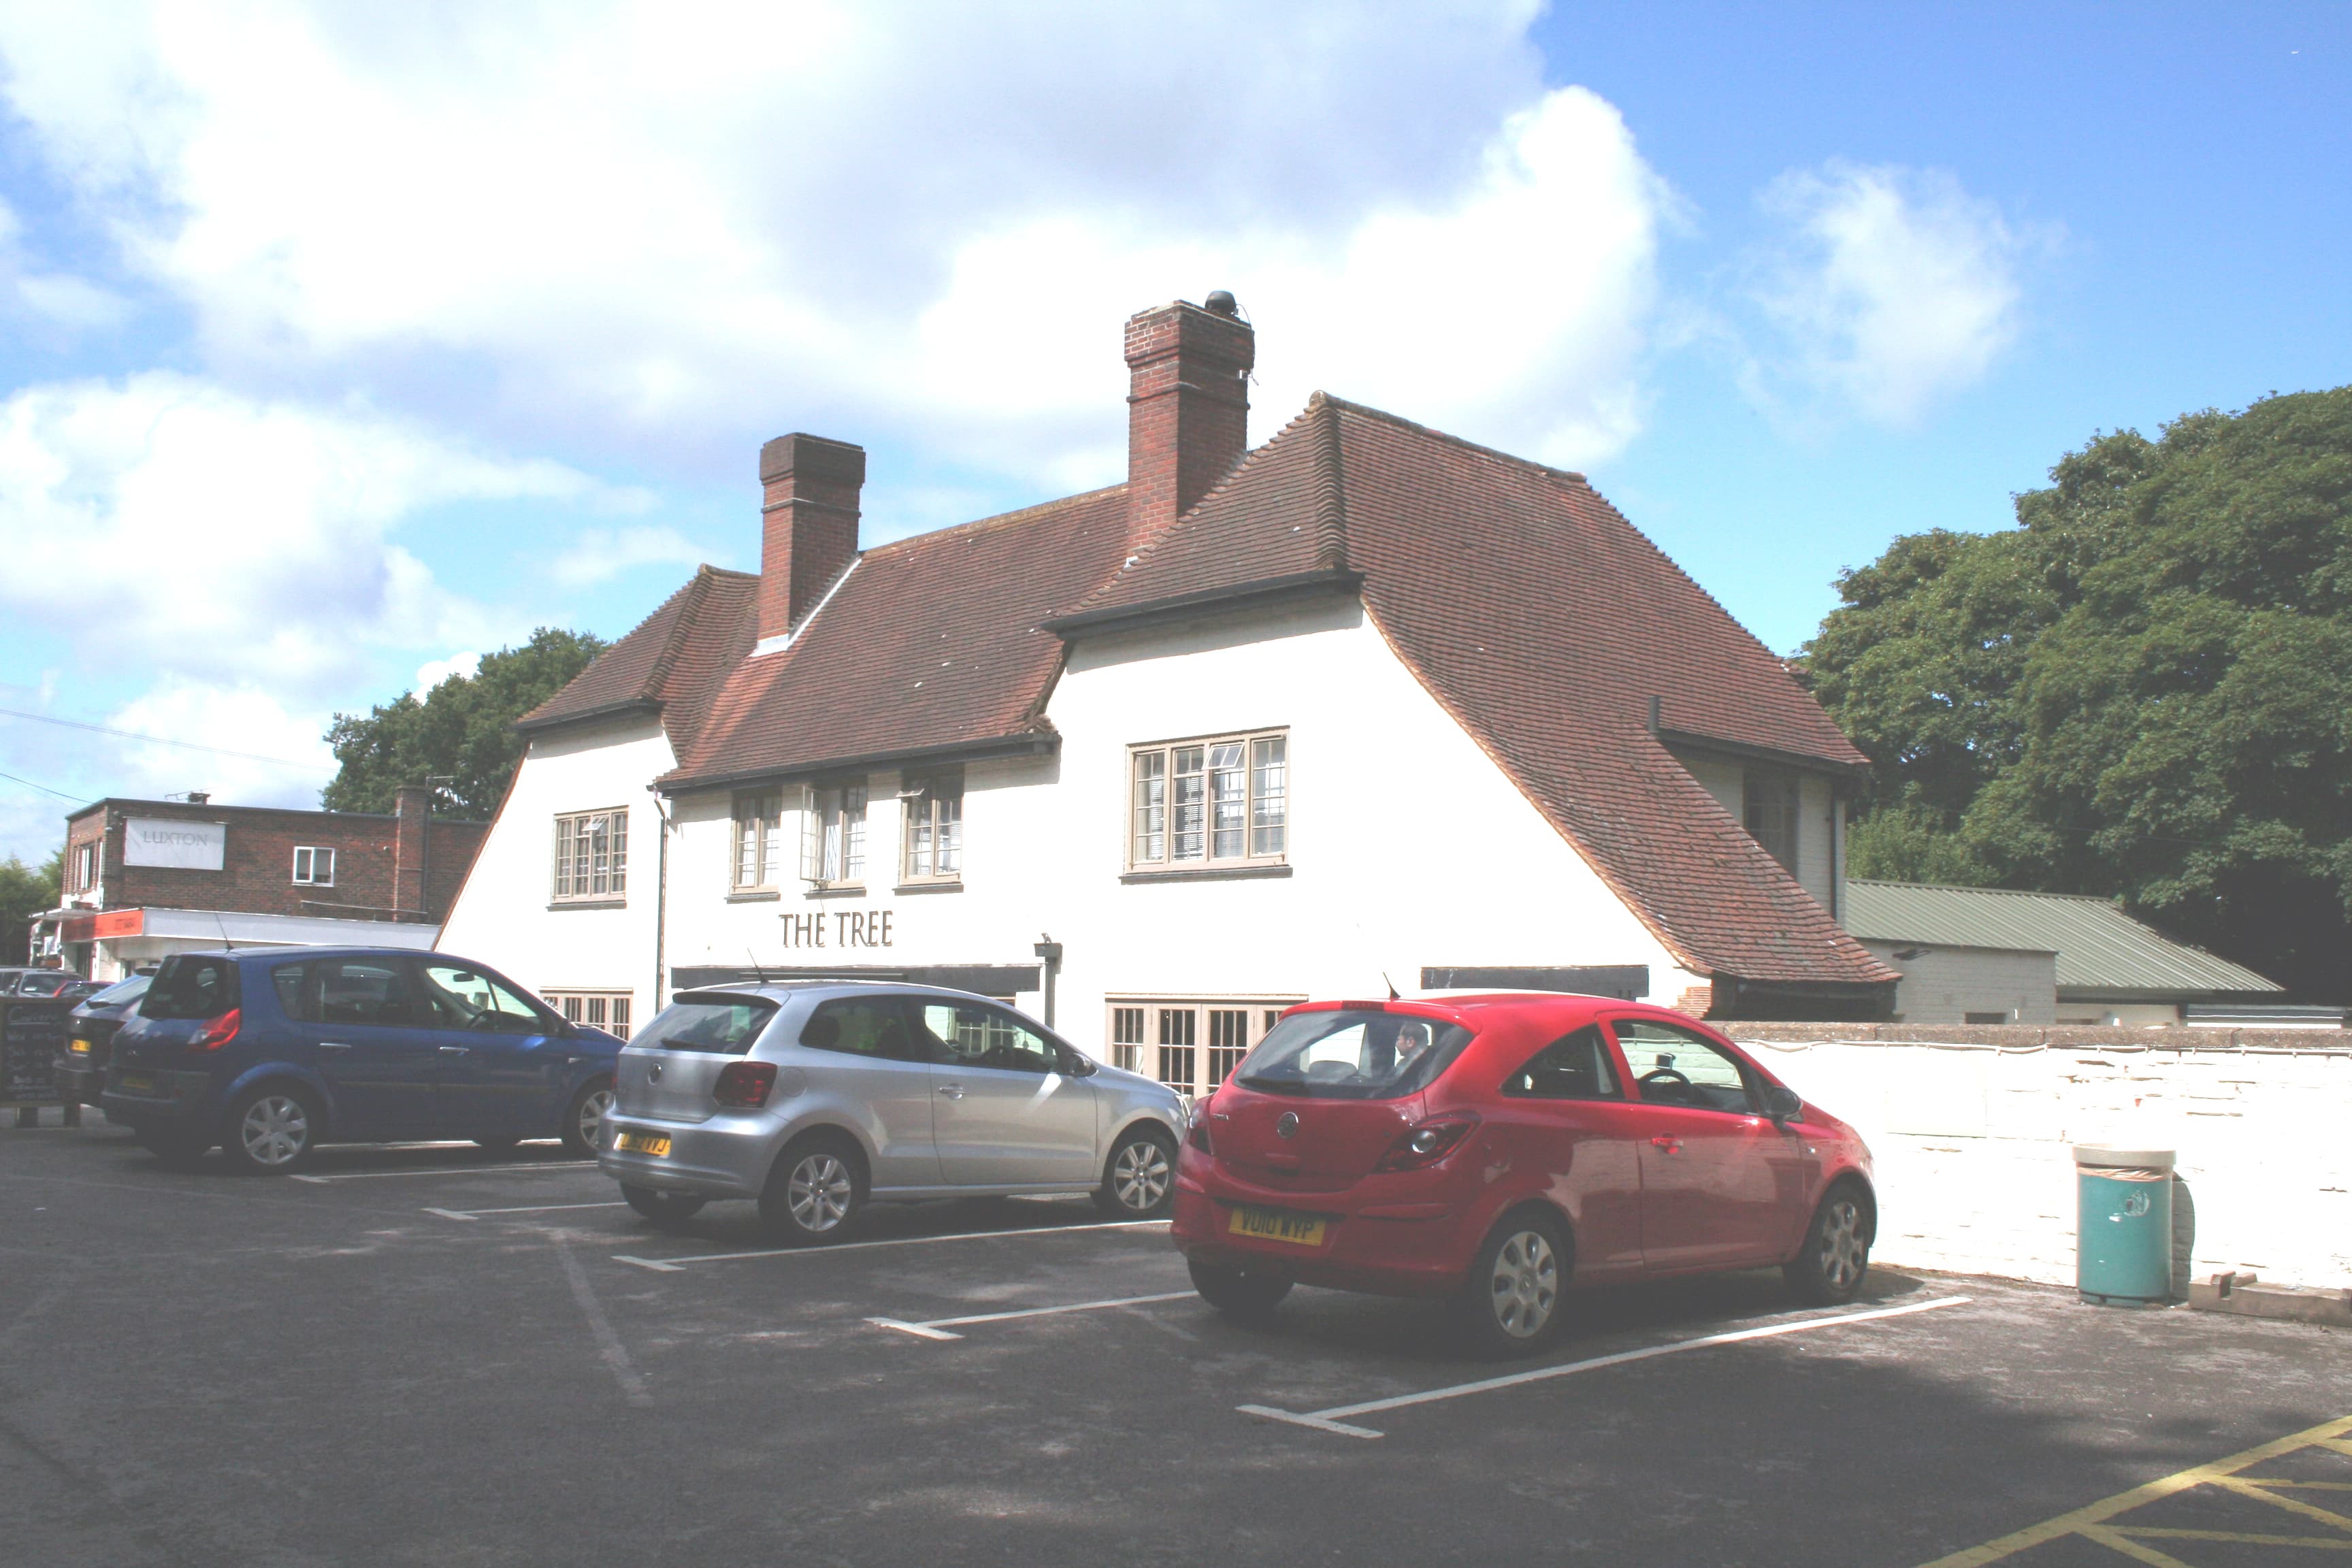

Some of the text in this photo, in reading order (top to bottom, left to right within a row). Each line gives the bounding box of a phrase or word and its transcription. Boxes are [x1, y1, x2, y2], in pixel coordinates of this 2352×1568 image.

[144, 831, 208, 846] LUXTON
[779, 911, 893, 947] THE TREE
